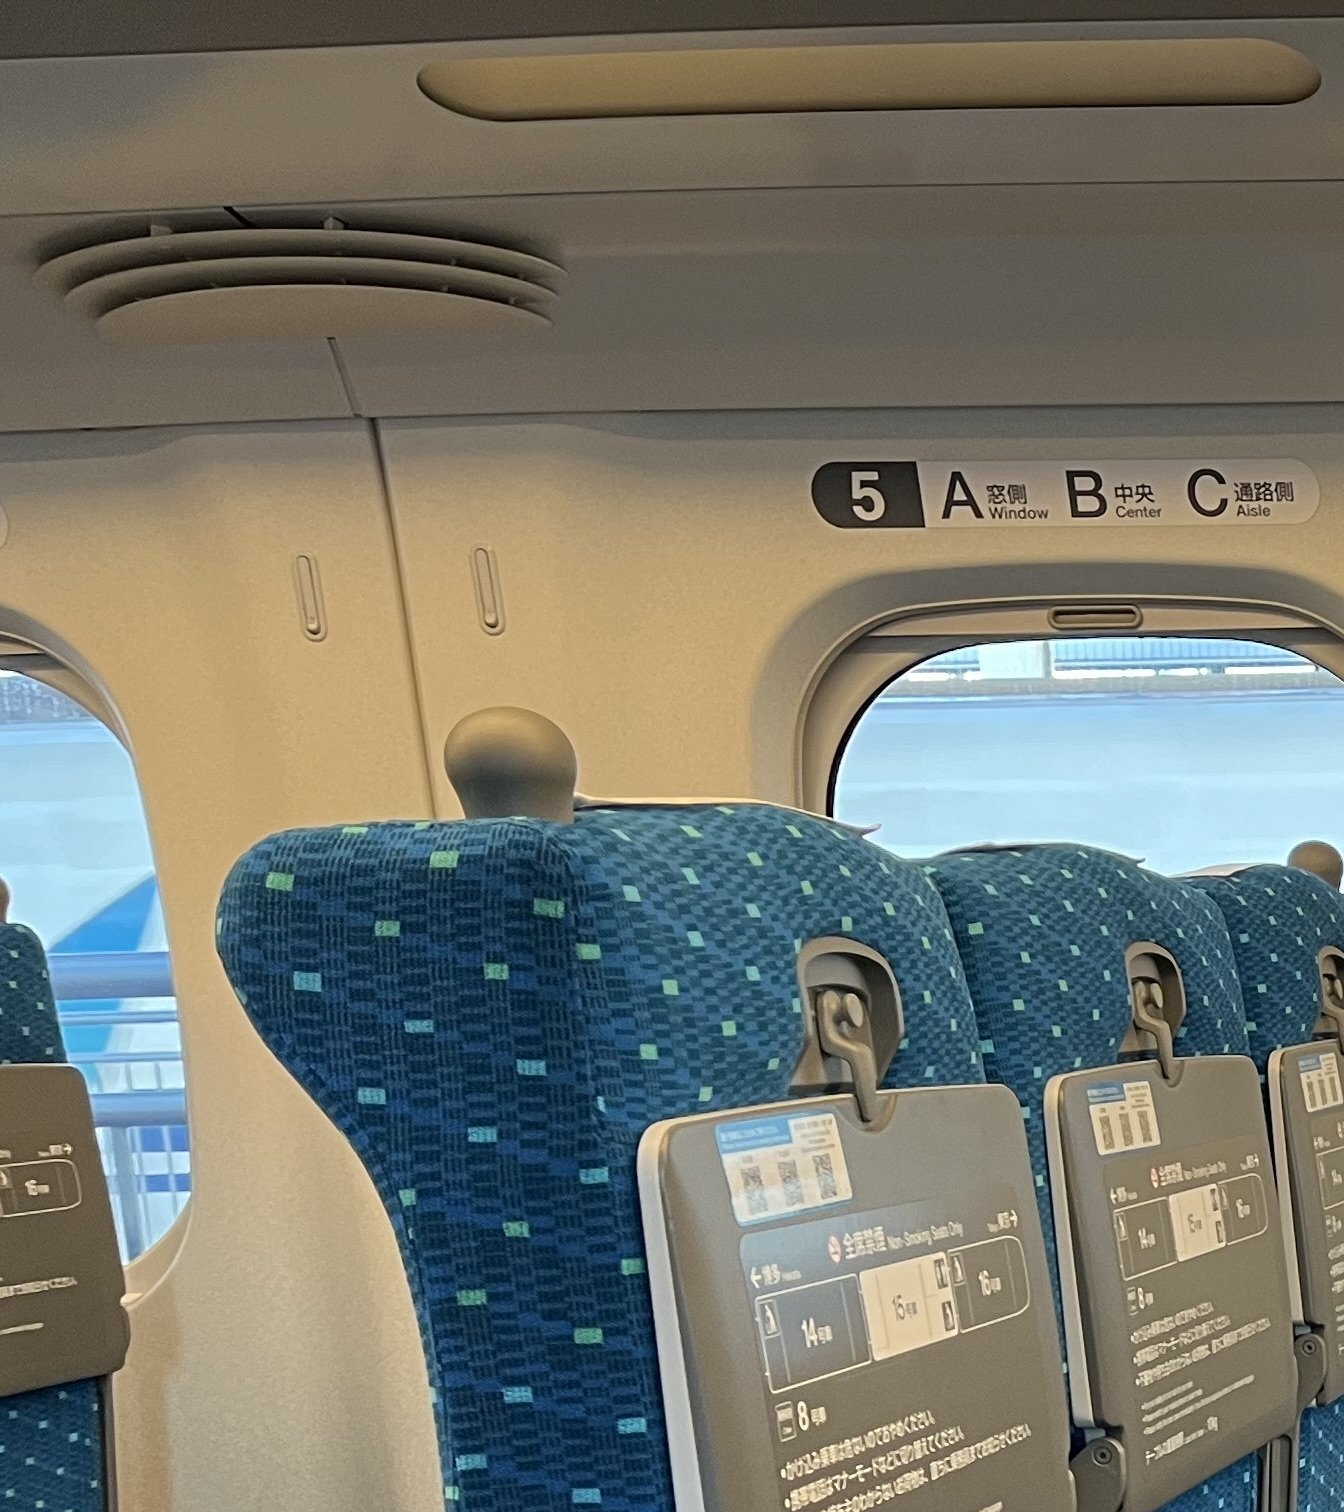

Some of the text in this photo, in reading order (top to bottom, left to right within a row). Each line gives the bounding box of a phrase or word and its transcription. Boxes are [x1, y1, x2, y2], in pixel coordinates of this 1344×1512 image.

[850, 468, 1294, 521] 5 A 窓側 B 中央 C 通路側
[988, 503, 1271, 521] Window Center Aisle
